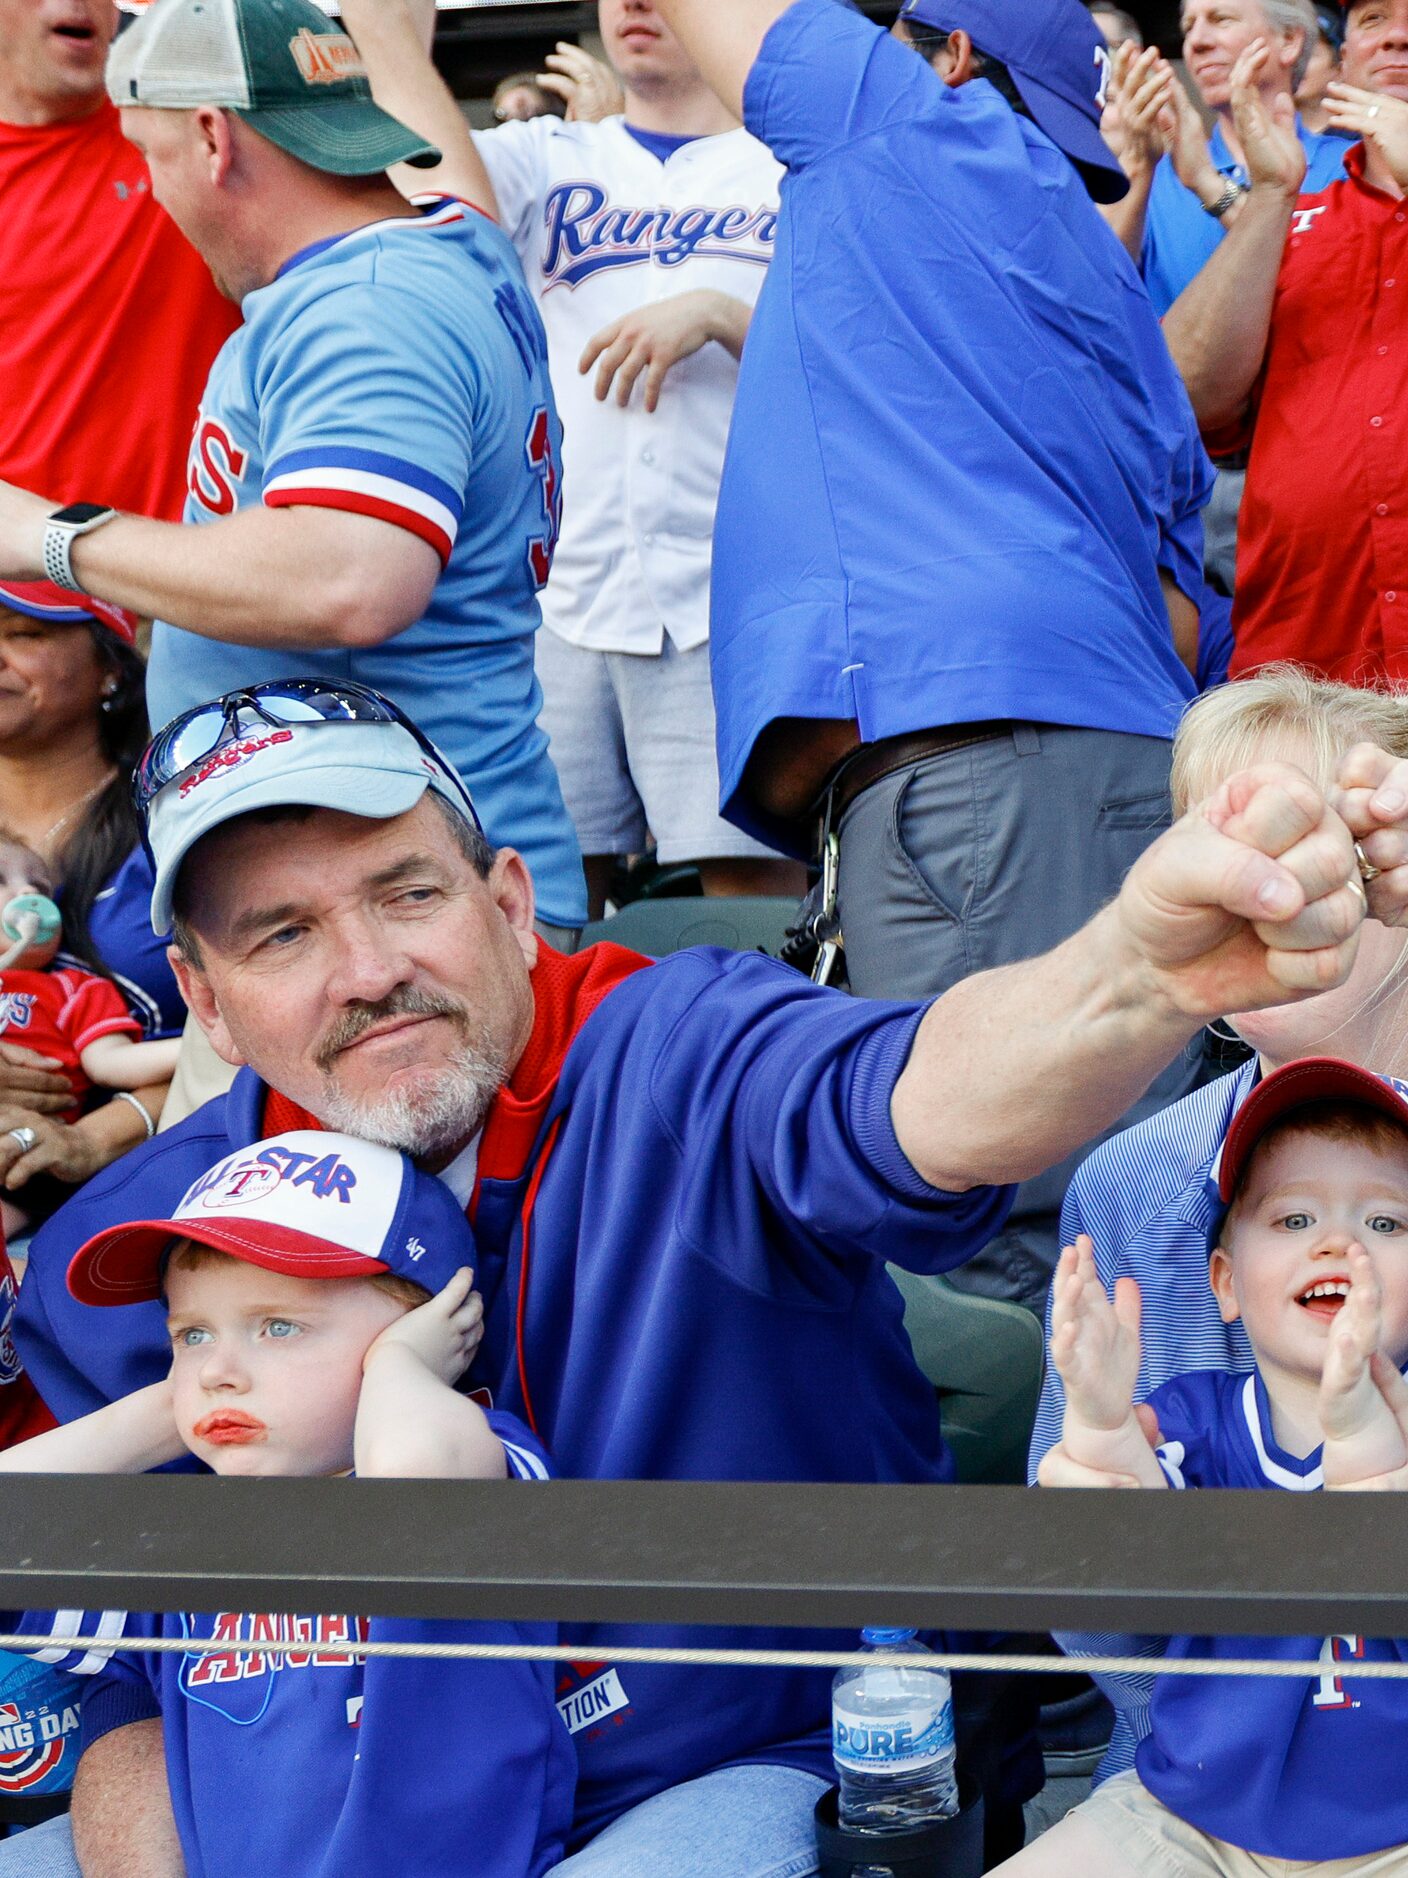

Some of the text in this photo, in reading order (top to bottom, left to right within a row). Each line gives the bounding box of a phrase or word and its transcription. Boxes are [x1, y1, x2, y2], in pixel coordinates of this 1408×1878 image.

[1291, 205, 1328, 234] T
[228, 1168, 271, 1197] T
[836, 1720, 914, 1756] PURE
